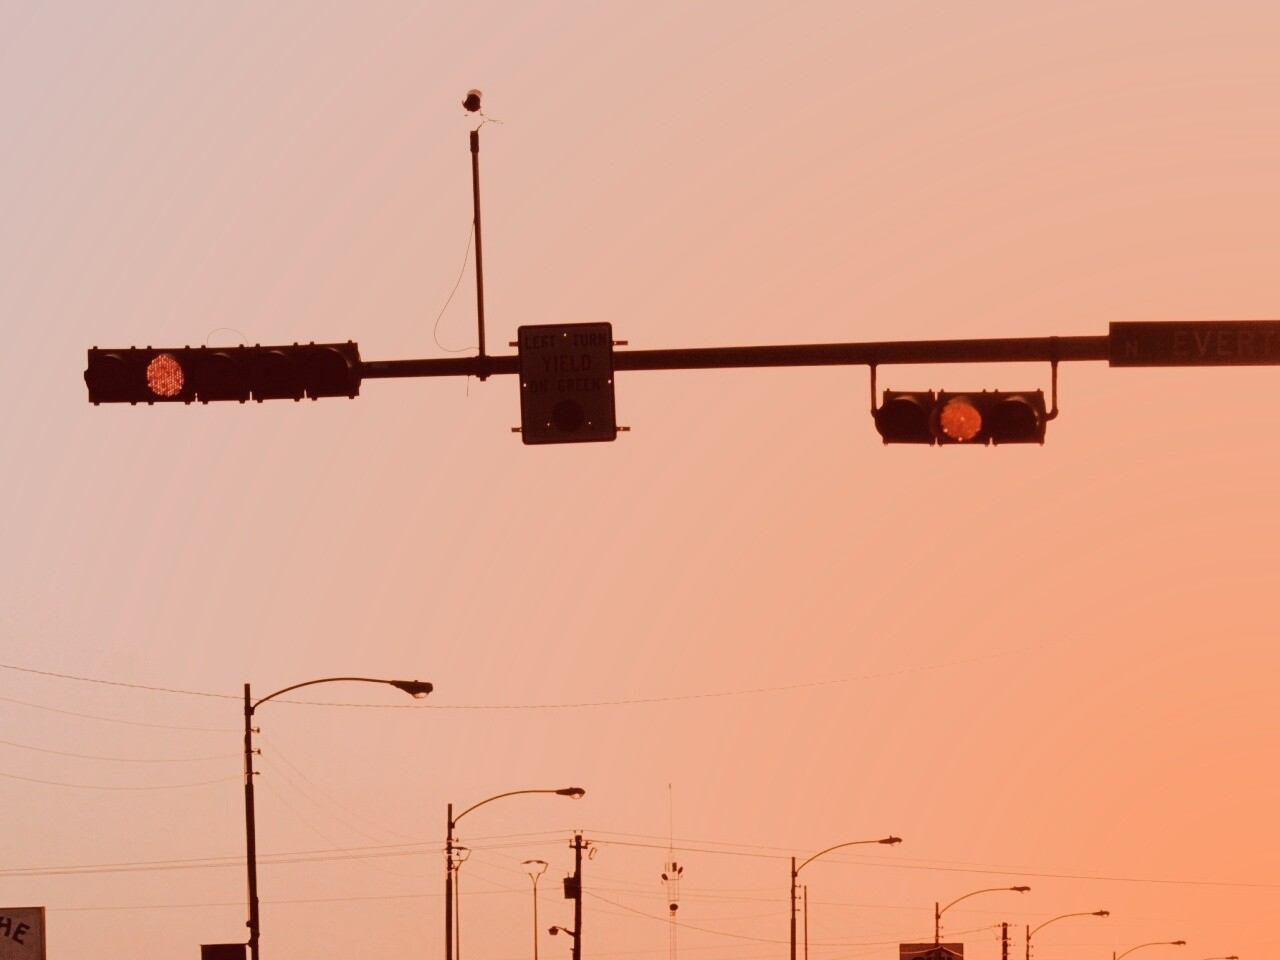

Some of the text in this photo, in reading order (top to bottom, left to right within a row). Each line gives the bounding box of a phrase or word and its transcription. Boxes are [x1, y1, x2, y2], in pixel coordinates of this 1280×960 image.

[524, 333, 607, 350] LEFT TURN
[542, 354, 592, 373] YIELD
[530, 378, 601, 394] ON GREEN
